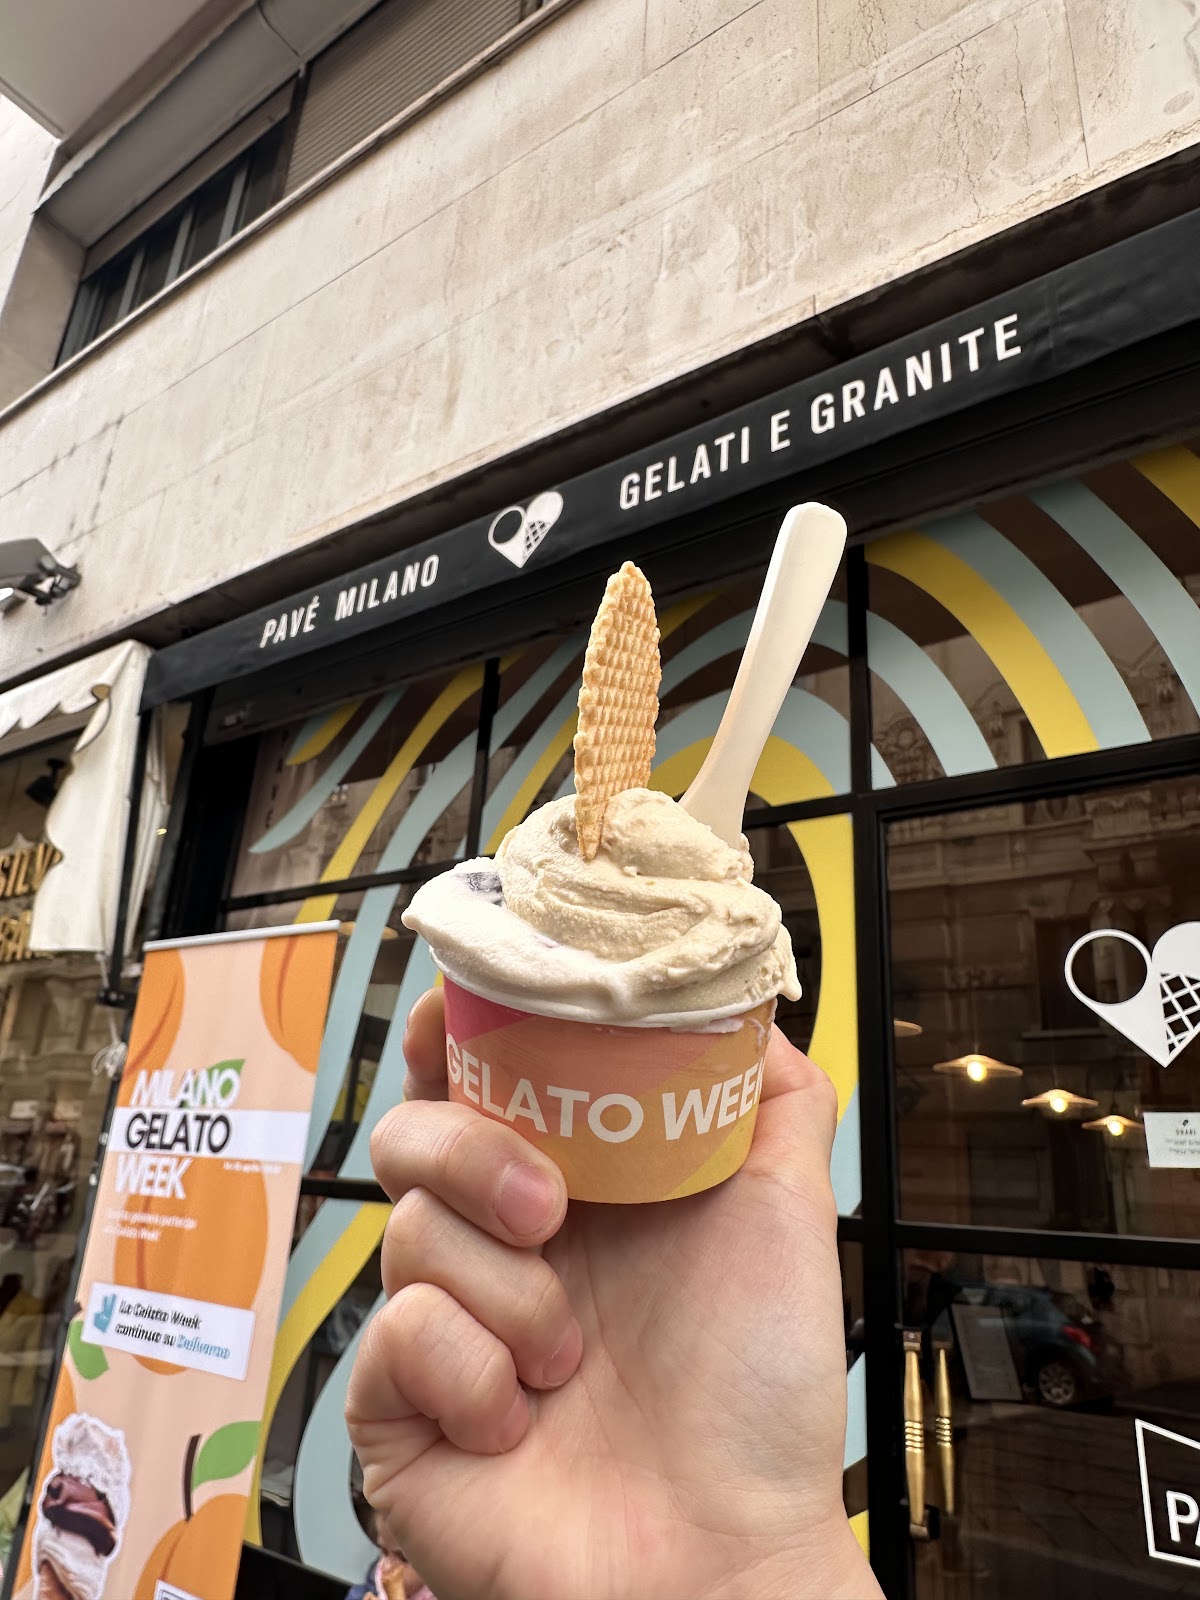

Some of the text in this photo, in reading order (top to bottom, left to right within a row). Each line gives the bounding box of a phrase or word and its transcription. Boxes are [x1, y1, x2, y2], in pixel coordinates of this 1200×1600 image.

[619, 313, 1023, 510] GELATI E GRANITE
[259, 554, 439, 649] PAVÉ MILANO
[130, 1068, 239, 1108] MILANO
[446, 1033, 644, 1143] GELATO
[126, 1112, 232, 1154] GELATO
[115, 1154, 193, 1199] WEEK
[1166, 1490, 1200, 1547] P
